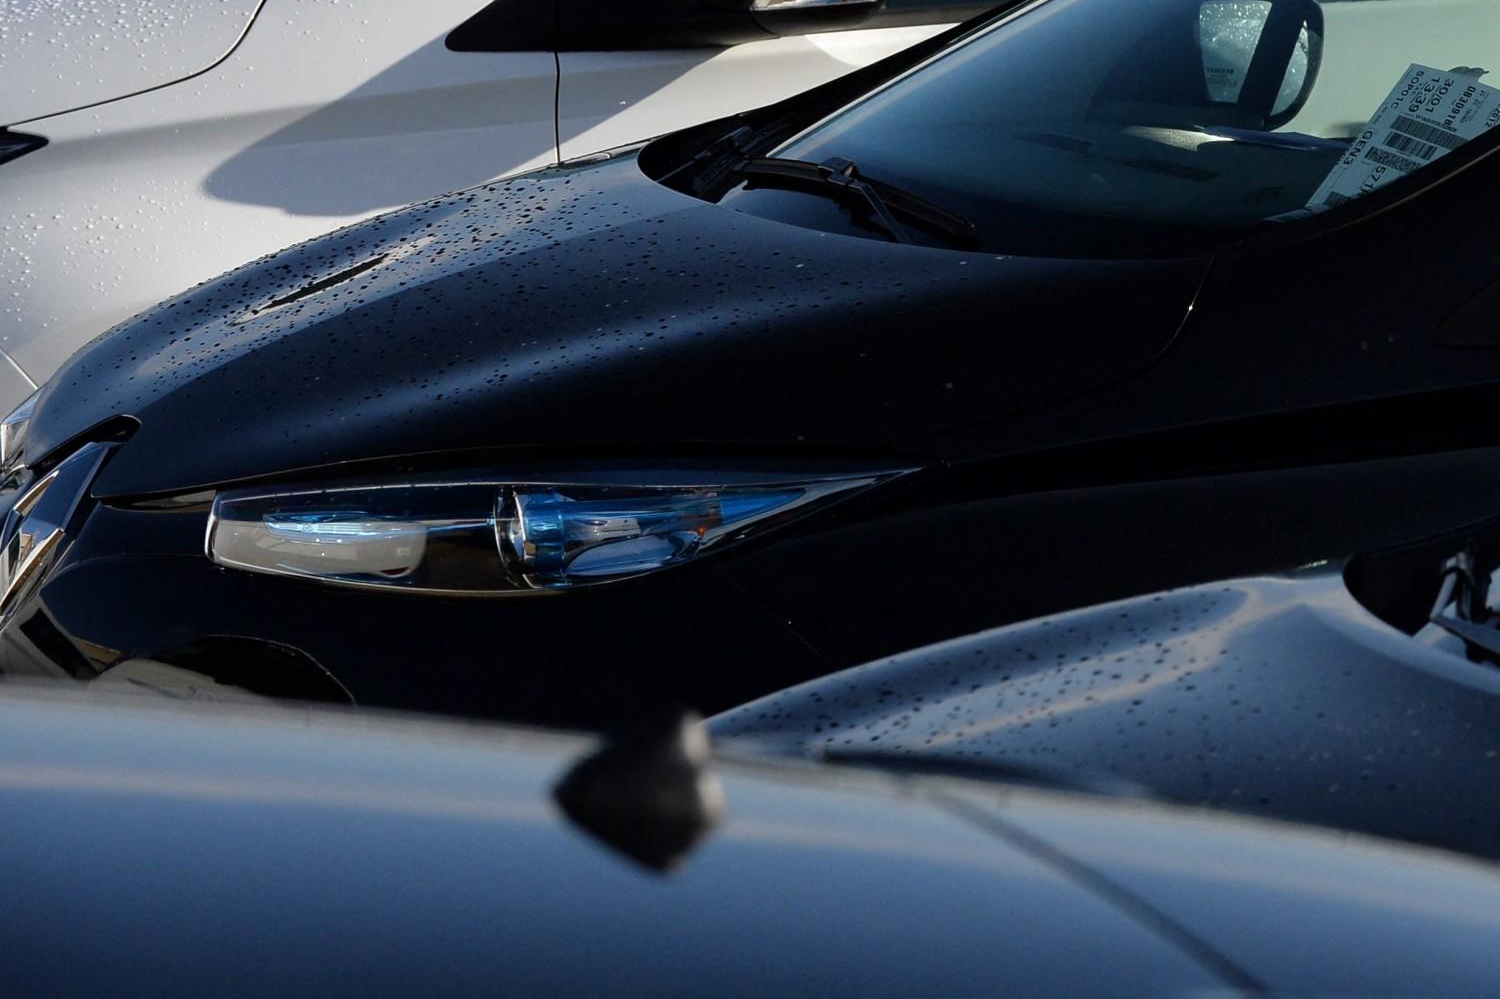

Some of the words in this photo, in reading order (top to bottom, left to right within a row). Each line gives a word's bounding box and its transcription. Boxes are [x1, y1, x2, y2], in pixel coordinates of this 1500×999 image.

[1408, 77, 1440, 113] 13:39
[1424, 78, 1455, 113] 30/01
[1443, 85, 1476, 126] 0830918
[1343, 130, 1373, 165] GEN3
